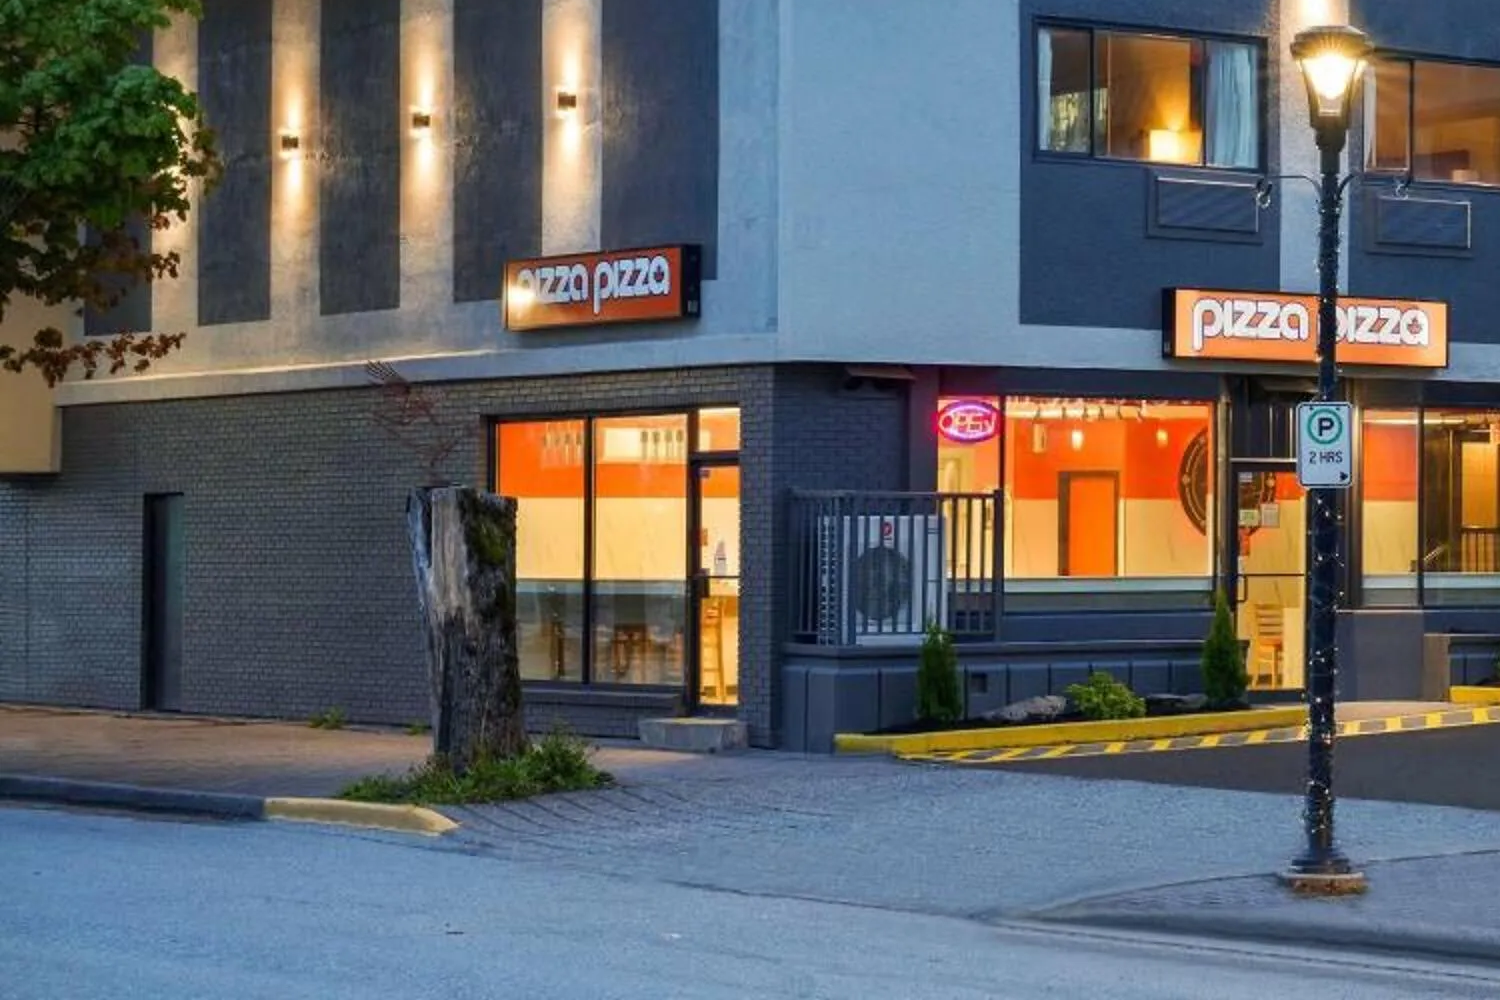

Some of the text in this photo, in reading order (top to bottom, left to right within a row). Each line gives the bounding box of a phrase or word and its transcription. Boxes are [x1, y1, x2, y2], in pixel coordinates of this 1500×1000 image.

[593, 256, 670, 314] pizza
[1193, 299, 1308, 350] pizza
[1317, 417, 1335, 437] P
[1309, 451, 1343, 464] 2 HRS
